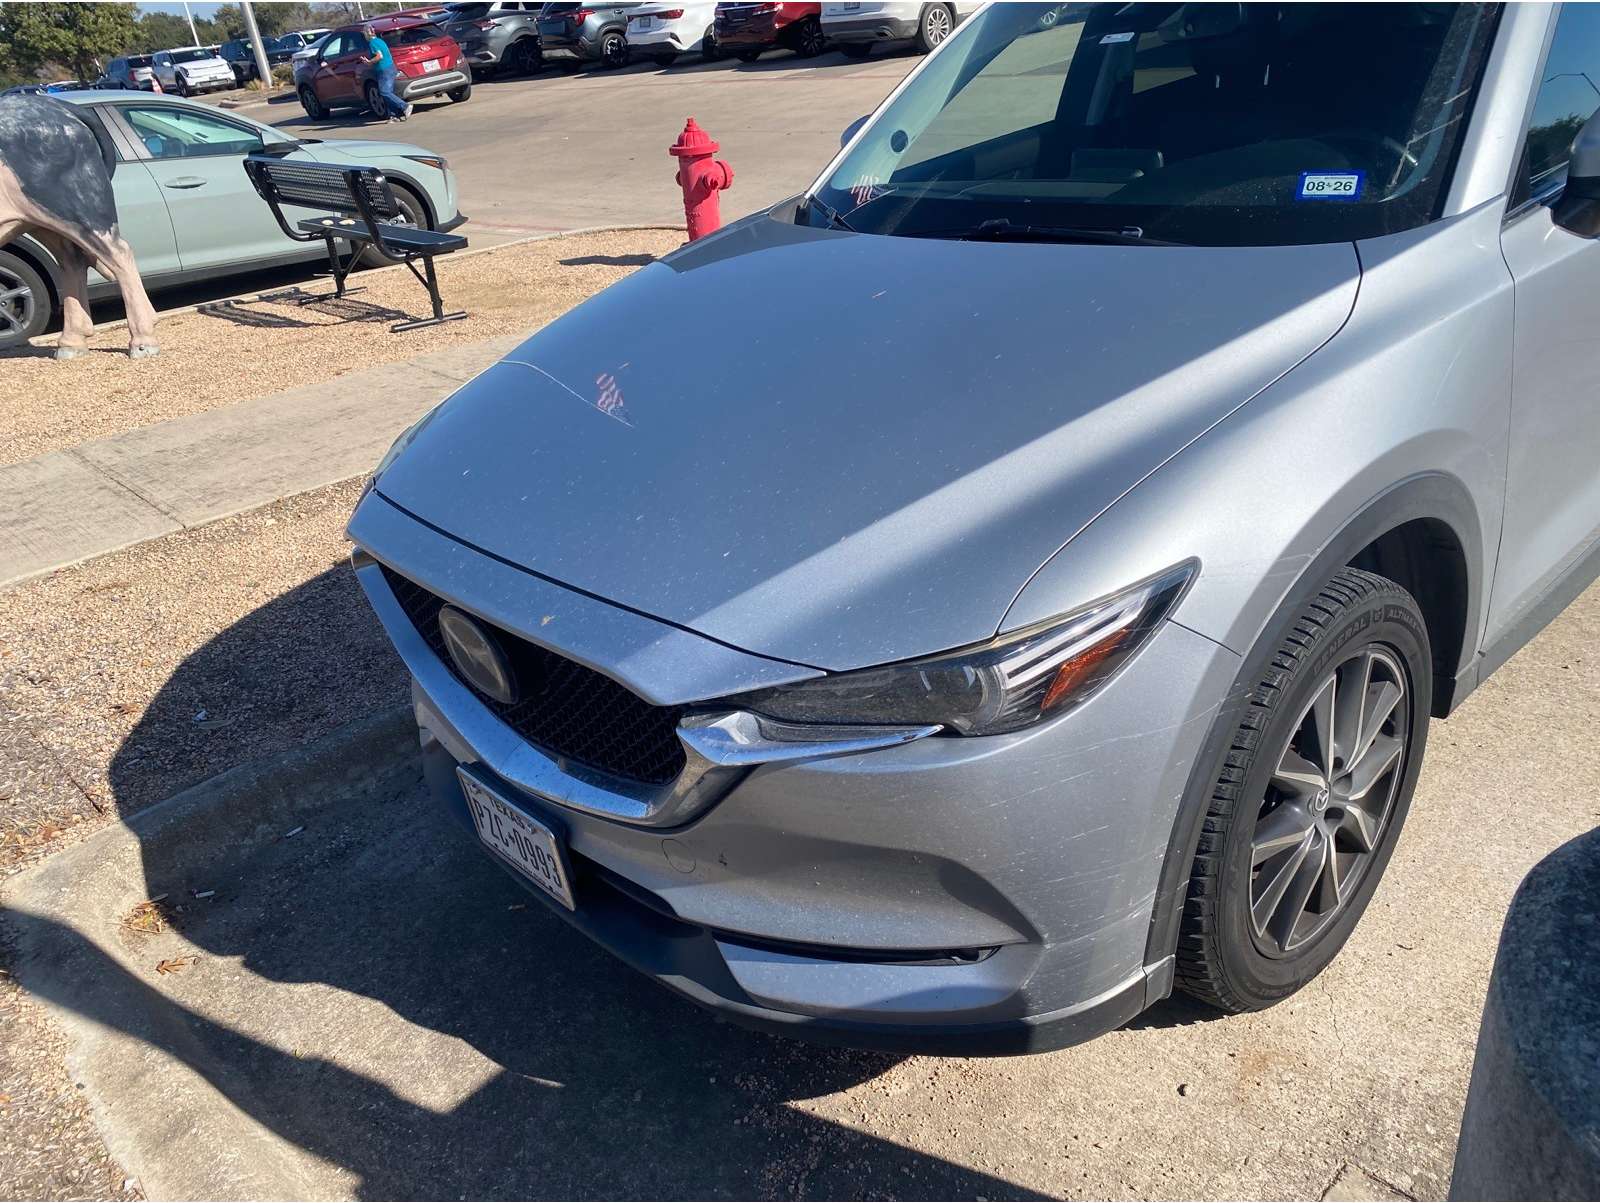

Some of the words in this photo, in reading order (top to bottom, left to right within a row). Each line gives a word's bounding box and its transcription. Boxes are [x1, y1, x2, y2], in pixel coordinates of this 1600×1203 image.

[1306, 181, 1326, 191] 08
[1333, 181, 1353, 191] 26
[490, 798, 525, 830] TEXAS
